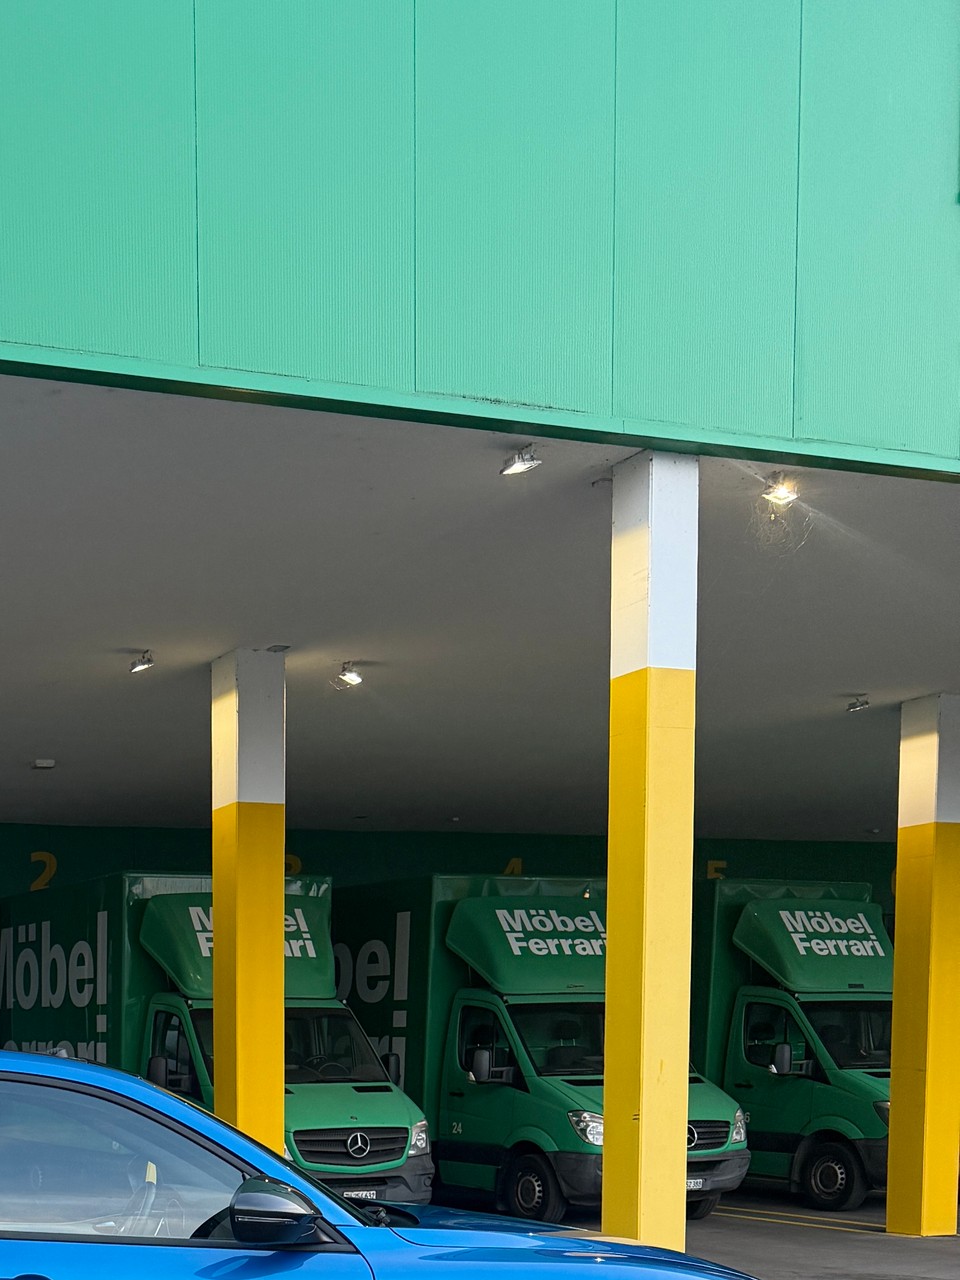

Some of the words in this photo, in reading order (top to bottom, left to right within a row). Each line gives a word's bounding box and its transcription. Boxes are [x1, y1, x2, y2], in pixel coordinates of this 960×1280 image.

[29, 851, 58, 892] 2
[495, 909, 605, 933] Möbel
[778, 910, 874, 934] Möbel
[790, 933, 886, 957] Ferrari
[451, 1121, 463, 1135] 24
